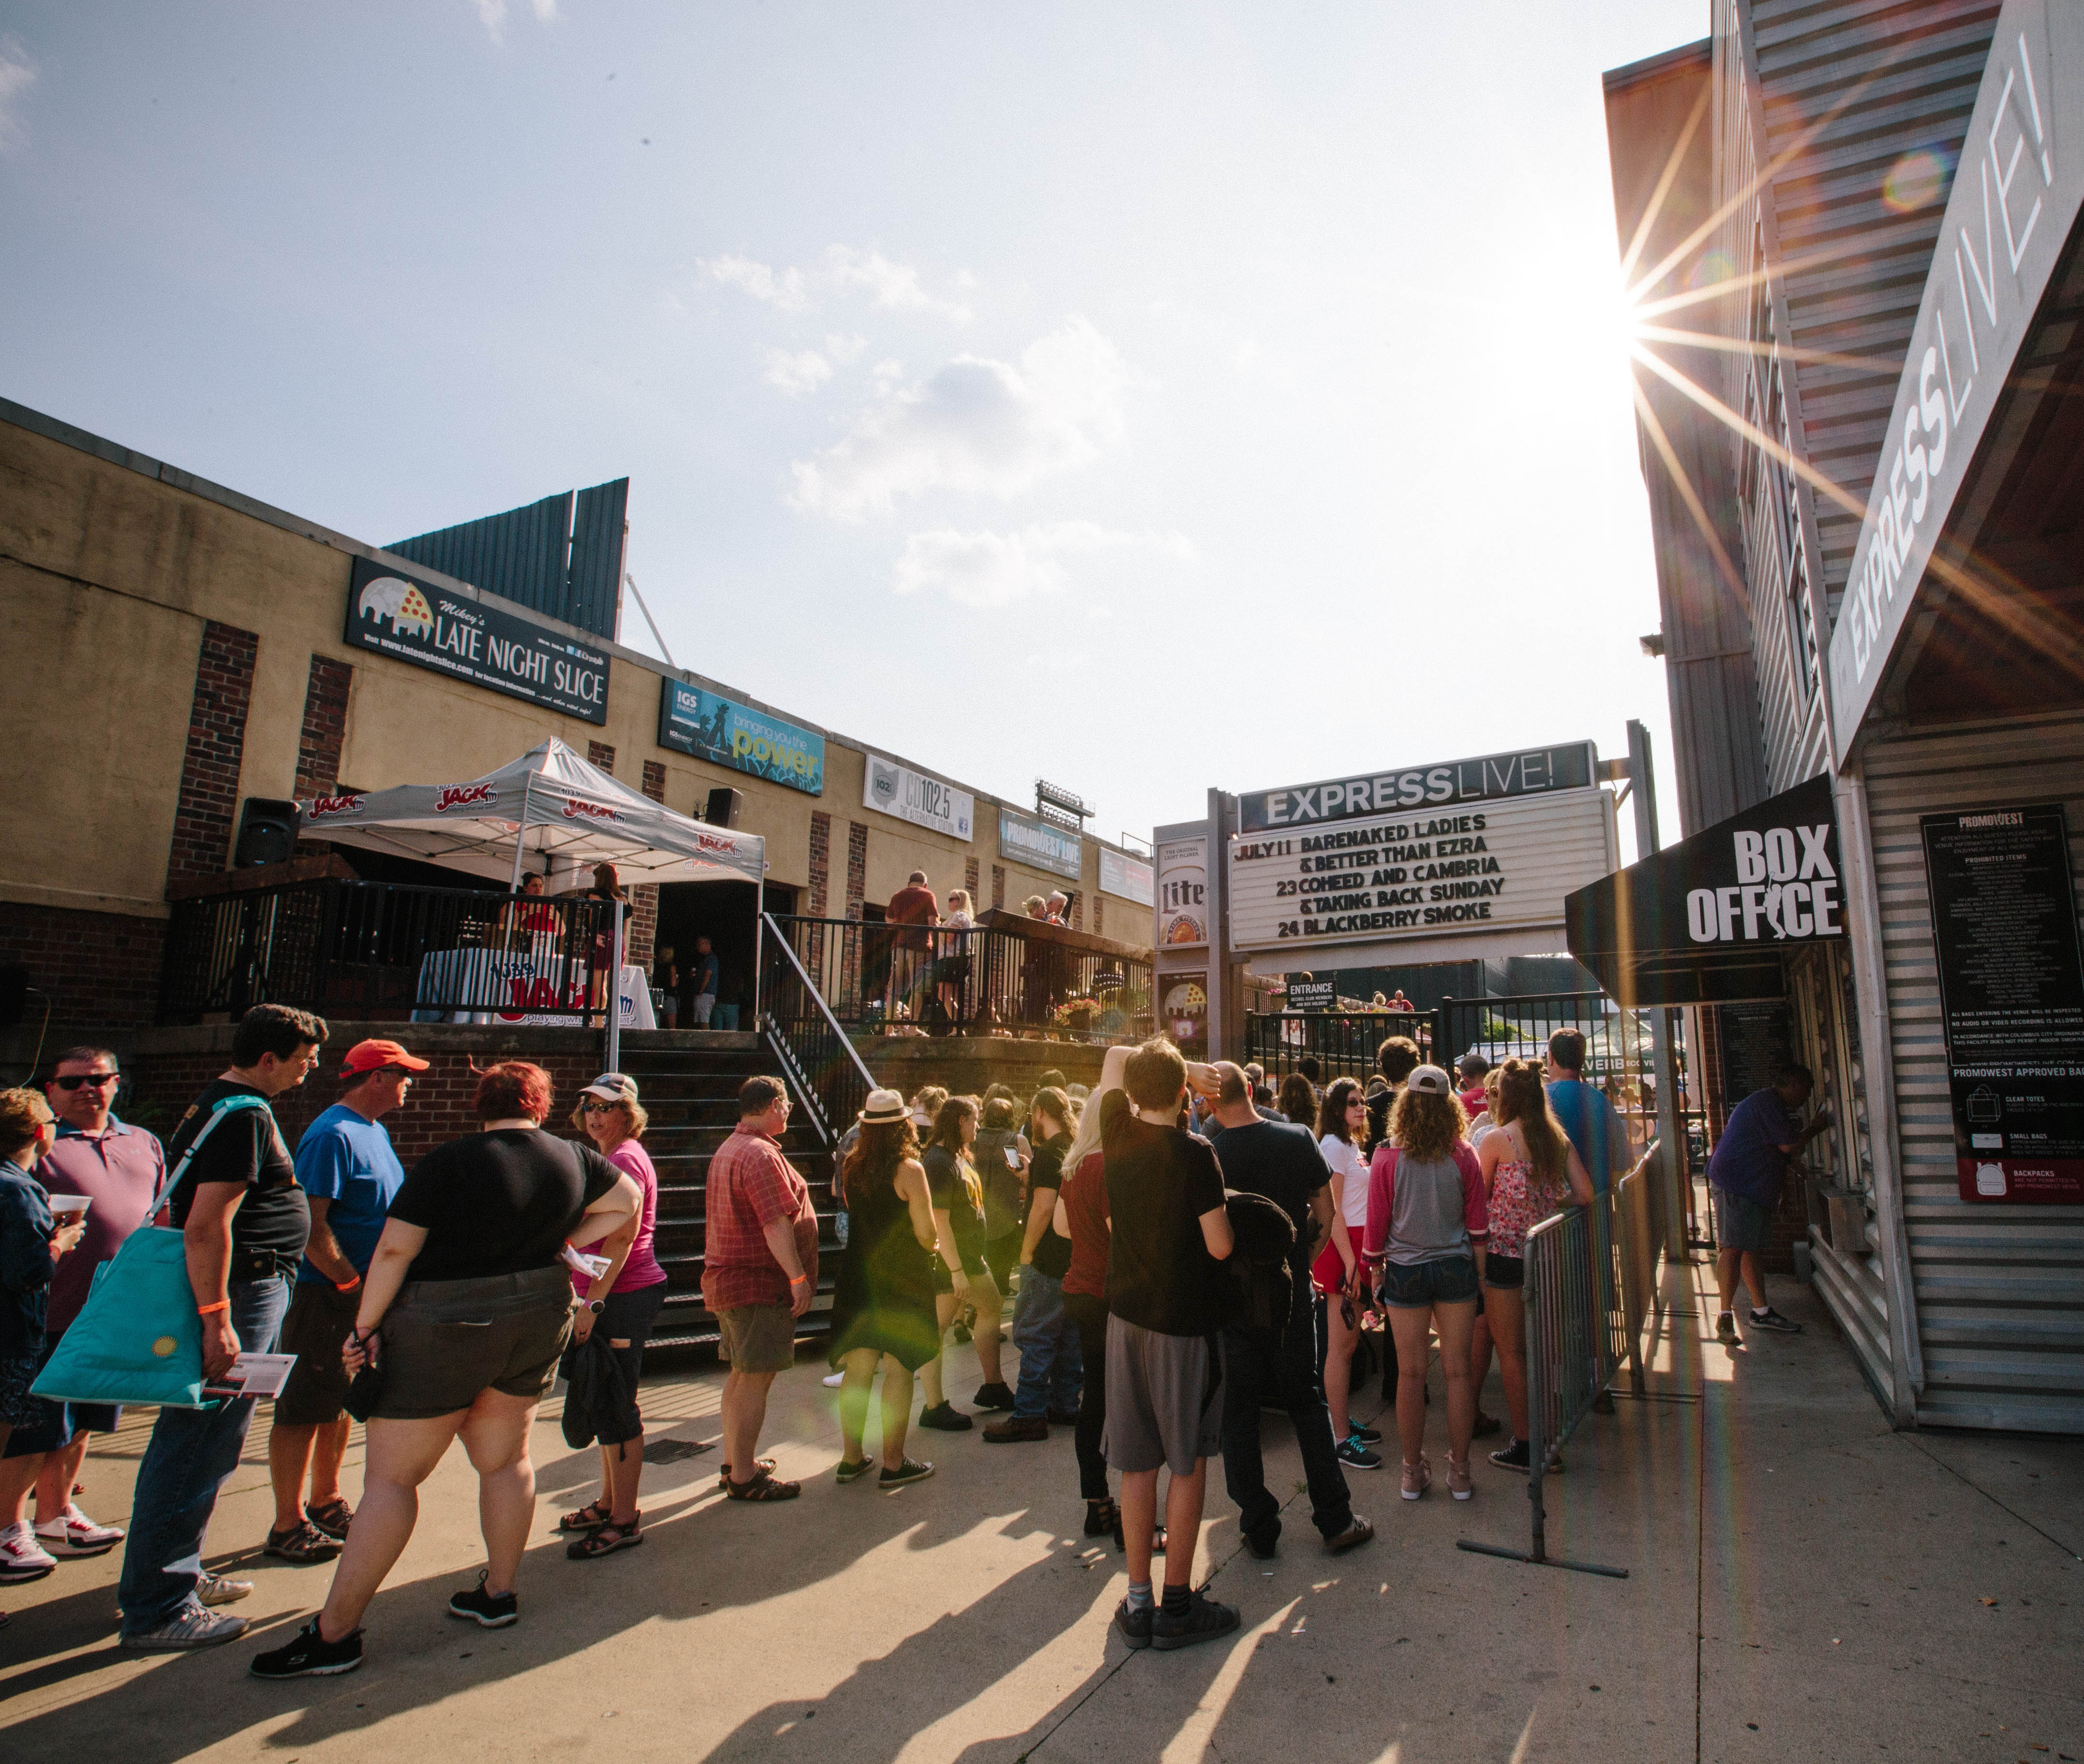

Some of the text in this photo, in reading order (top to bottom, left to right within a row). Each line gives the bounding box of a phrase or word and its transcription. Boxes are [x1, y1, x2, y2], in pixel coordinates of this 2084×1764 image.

[439, 600, 486, 626] Mikey's
[364, 633, 379, 644] Visit
[381, 638, 473, 676] www.latenightslice.com
[505, 681, 535, 696] information
[435, 616, 604, 705] LATE NIGHT SLICE
[677, 690, 697, 708] IGS
[677, 704, 696, 715] ENERGY
[734, 713, 807, 750] bringing you the
[733, 728, 817, 778] power
[561, 788, 581, 796] 103.9
[900, 805, 955, 834] THE ALTERNATIVE STATION
[1959, 812, 2023, 828] PROMOWEST
[1062, 840, 1079, 864] LIVE
[1234, 841, 1274, 861] JULY
[1301, 824, 1409, 853] BARENAKED
[1414, 814, 1486, 838] LADIES
[1315, 849, 1378, 872] BETTER
[1382, 842, 1431, 863] THAN
[1436, 836, 1488, 857] EZRA
[1733, 824, 1836, 884] BOX
[1277, 856, 1500, 896] 23 COHEED AND CAMBRIA
[1965, 855, 2004, 864] PROHIBITED
[1161, 880, 1204, 915] Lite
[1314, 892, 1372, 913] TAKING
[1377, 887, 1424, 907] BACK
[1430, 878, 1505, 901] SUNDAY
[1278, 902, 1491, 937] 24 BLACKBERRY SMOKE
[1290, 983, 1333, 995] ENTRANCE
[1953, 1068, 2012, 1077] PROMOWEST
[2016, 1067, 2066, 1076] APPROVED
